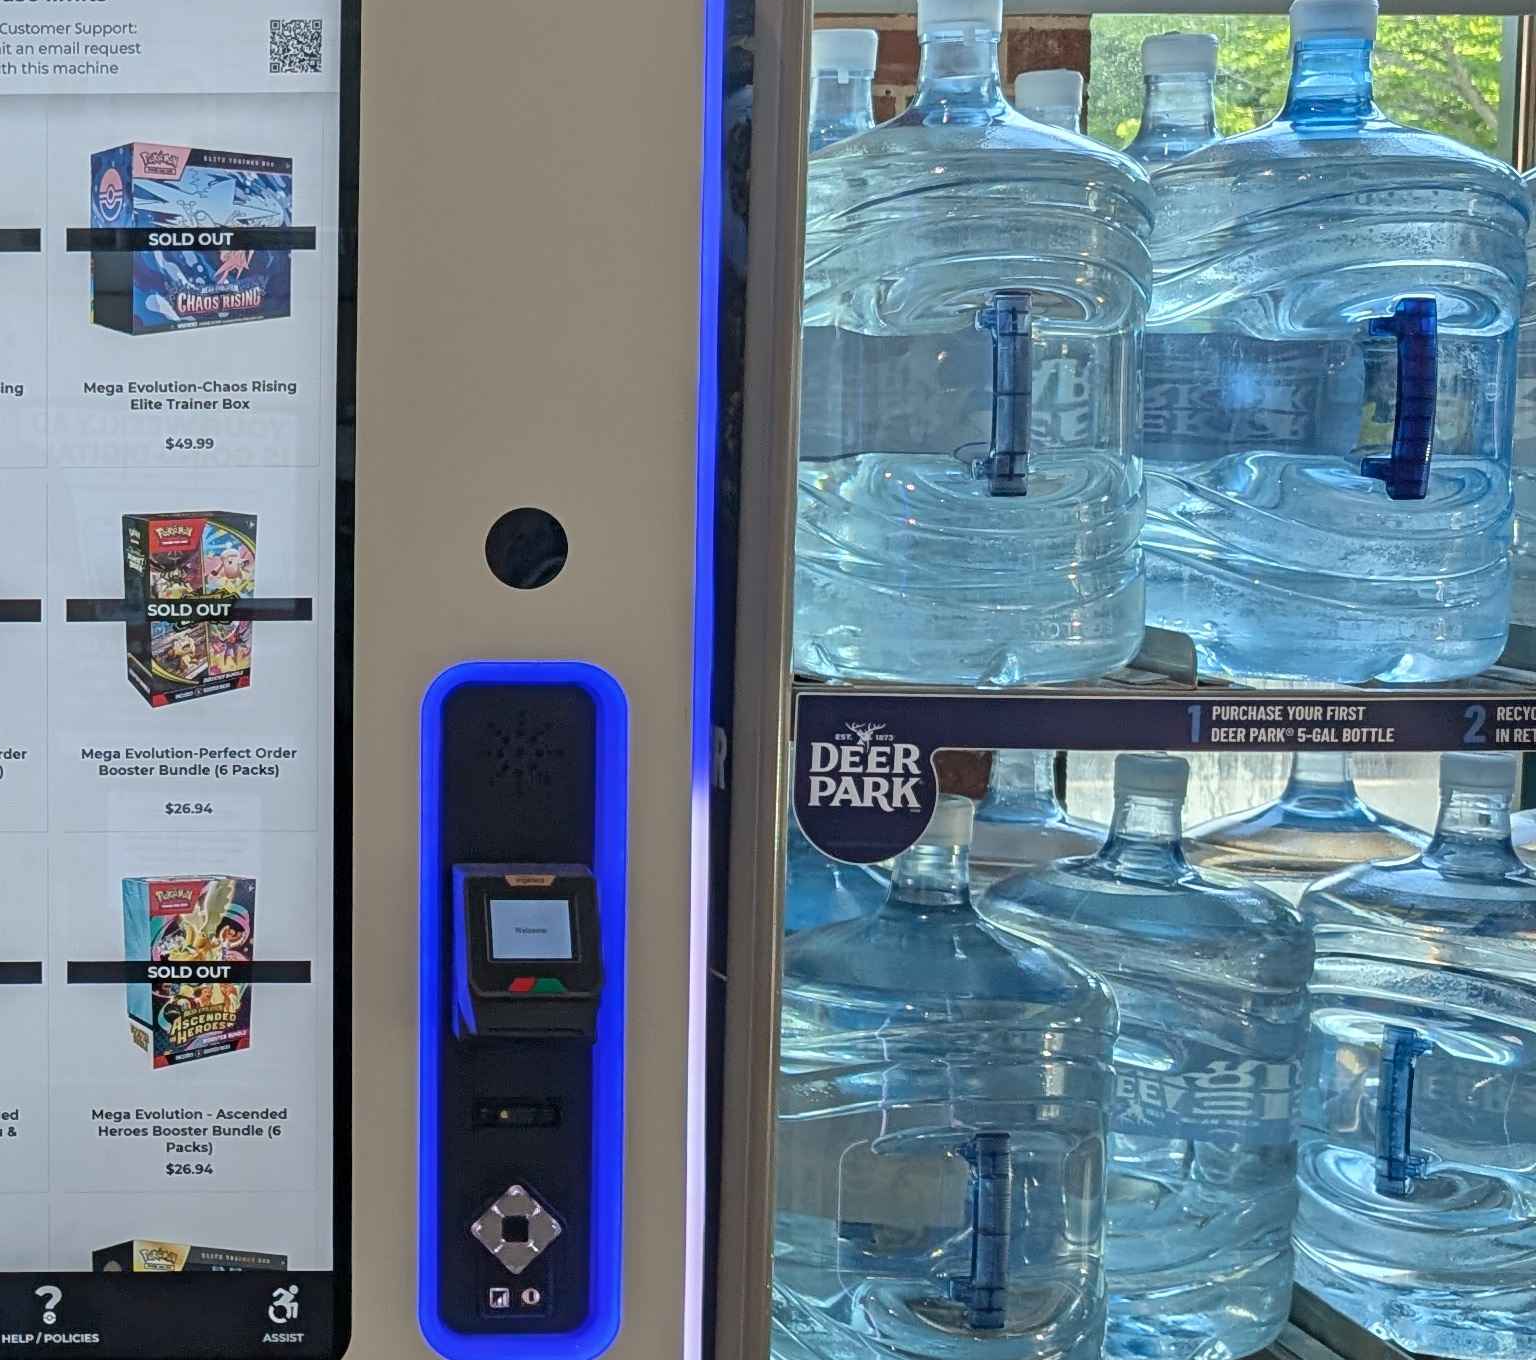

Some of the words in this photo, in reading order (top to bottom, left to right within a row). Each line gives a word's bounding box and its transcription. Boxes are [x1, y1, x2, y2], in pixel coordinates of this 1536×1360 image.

[74, 22, 137, 38] Support:
[15, 44, 35, 55] an
[38, 41, 80, 55] email
[84, 42, 142, 57] request
[21, 61, 50, 75] this
[52, 60, 119, 75] machine
[148, 232, 195, 247] SOLD
[197, 232, 235, 246] OUT
[83, 381, 124, 397] Mega
[127, 380, 248, 394] Evolution-Chaos
[251, 379, 297, 395] Rising
[130, 398, 163, 411] Elite
[165, 397, 219, 410] Trainer
[222, 398, 251, 410] Box
[165, 436, 215, 451] $49.99
[1211, 705, 1284, 721] PURCHASE
[1286, 705, 1323, 721] YOUR
[1326, 706, 1367, 721] FIRST
[1187, 704, 1202, 744] 1
[1210, 727, 1246, 743] DEER
[1297, 727, 1339, 743] 5-GAL
[1342, 727, 1395, 743] BOTTLE
[809, 742, 922, 774] DEER
[808, 776, 921, 812] PARK
[1, 1333, 35, 1344] HELP
[43, 1333, 100, 1344] POLICIES
[262, 1332, 305, 1343] ASSIST
